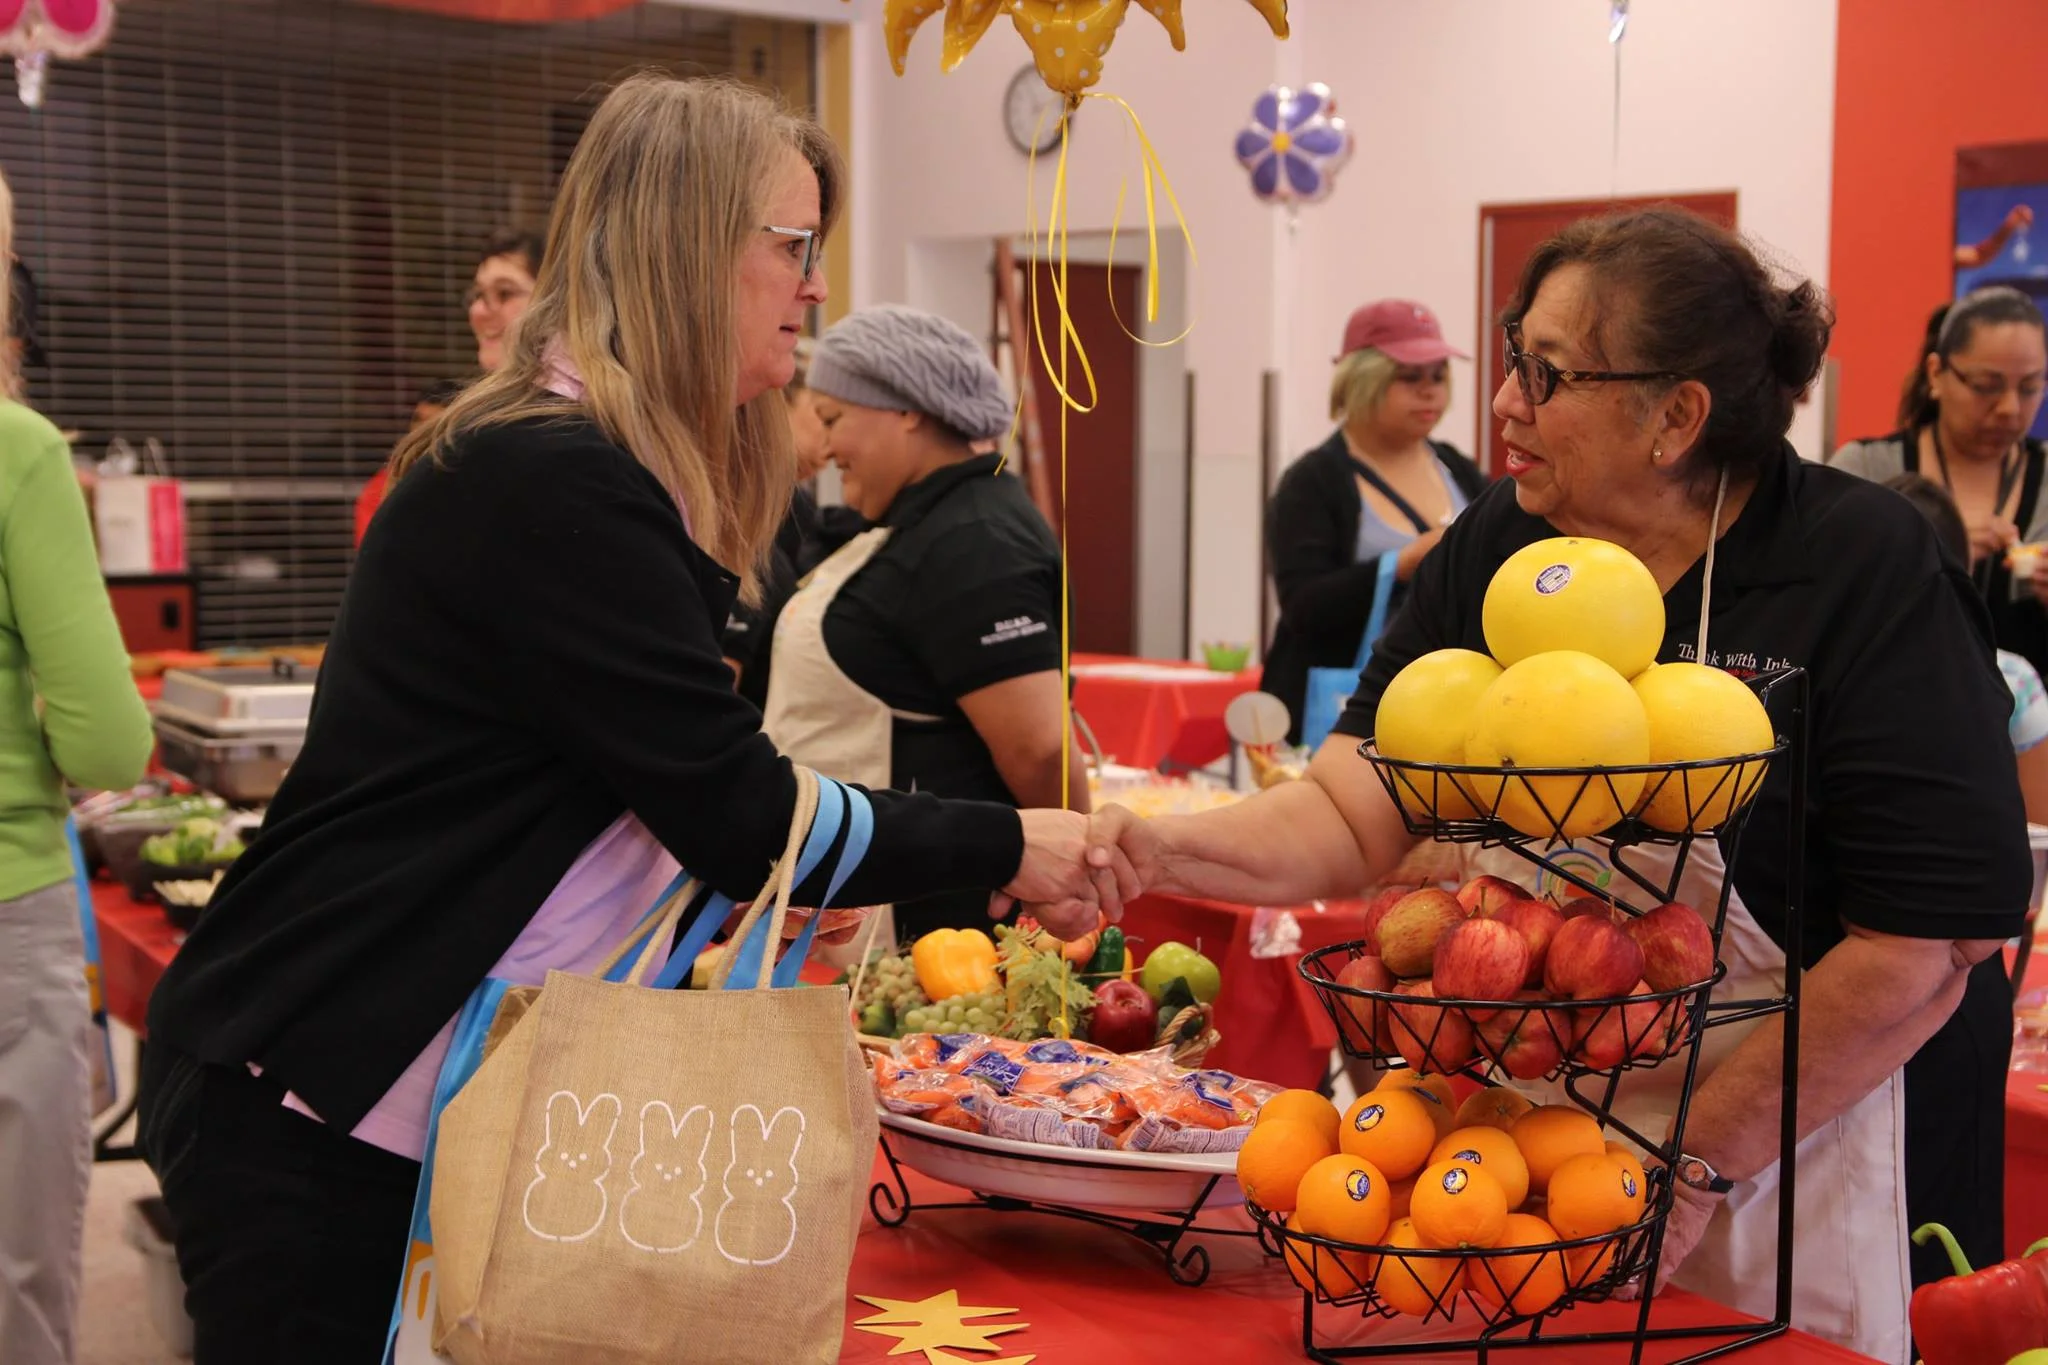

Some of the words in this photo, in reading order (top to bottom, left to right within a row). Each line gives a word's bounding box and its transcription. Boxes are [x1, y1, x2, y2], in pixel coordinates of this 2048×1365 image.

[1678, 643, 1719, 666] Thk
[1726, 652, 1757, 669] With
[1762, 656, 1792, 671] Ink
